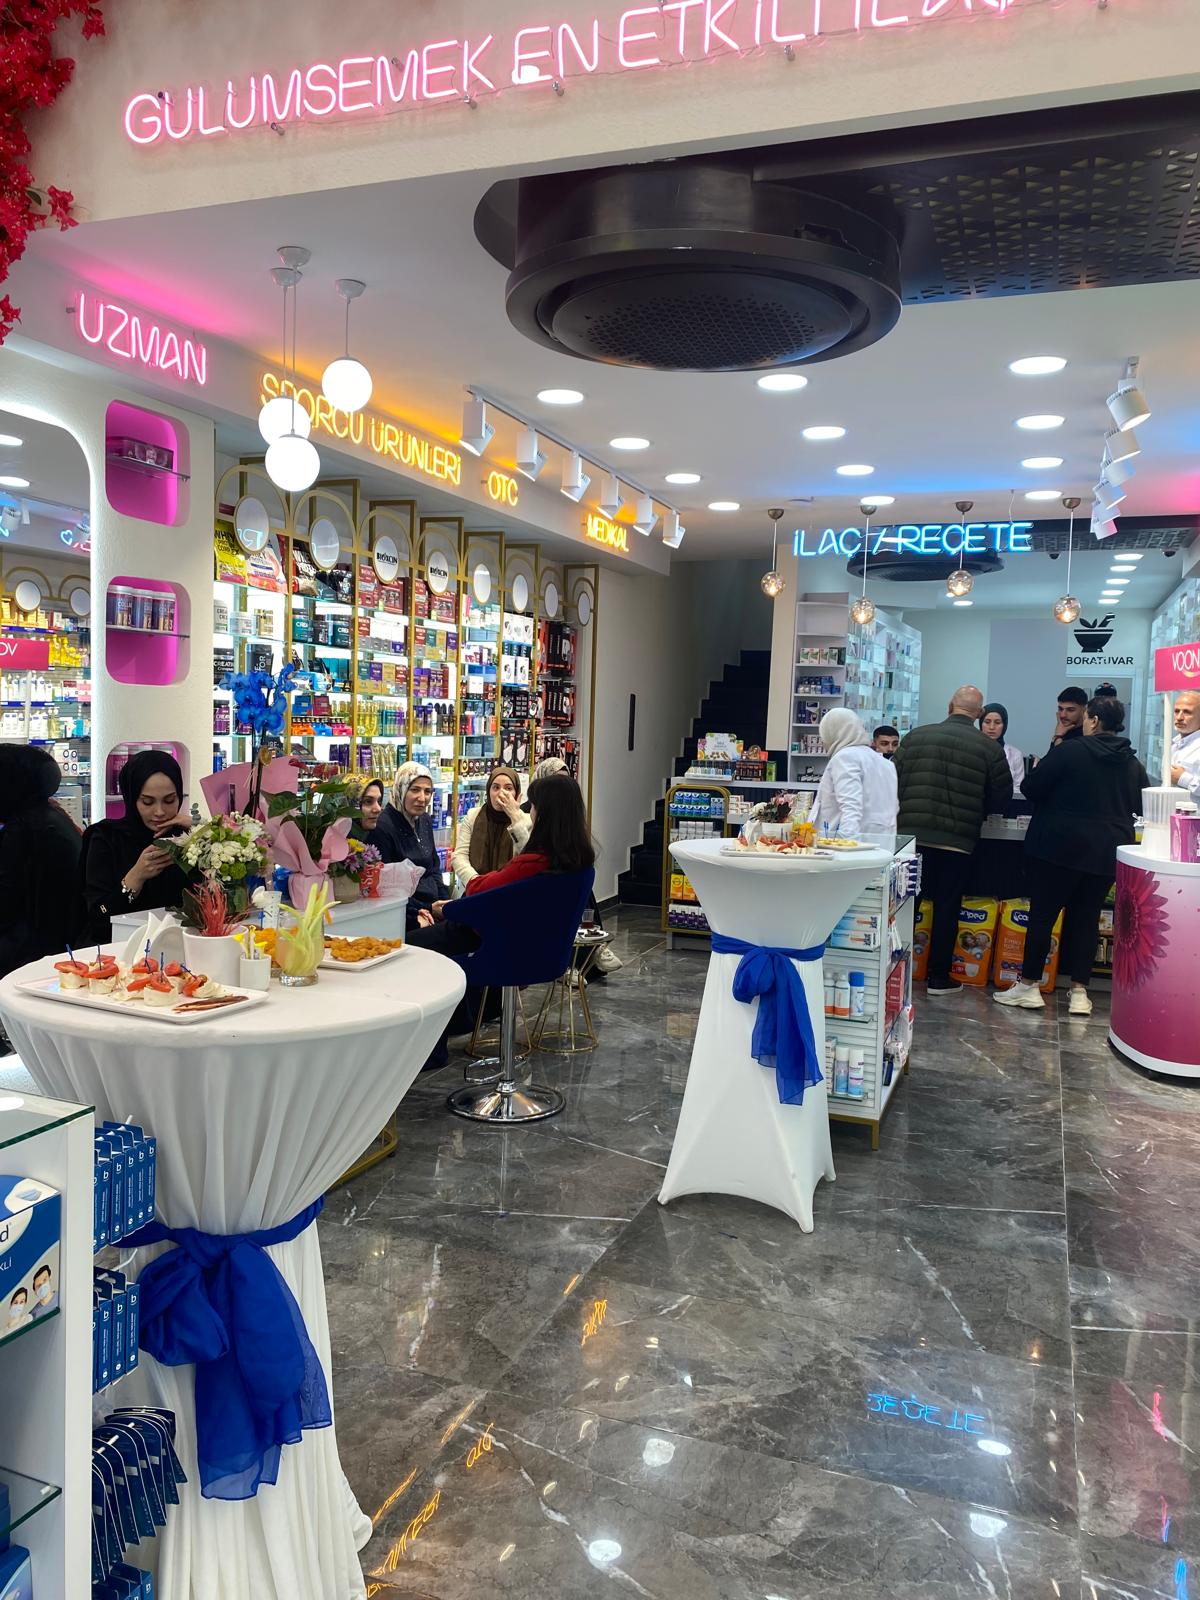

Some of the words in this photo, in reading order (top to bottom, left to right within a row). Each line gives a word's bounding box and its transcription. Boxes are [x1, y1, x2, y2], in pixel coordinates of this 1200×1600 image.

[511, 20, 598, 84] EN
[79, 292, 207, 386] UZMAN
[487, 471, 519, 507] OTC
